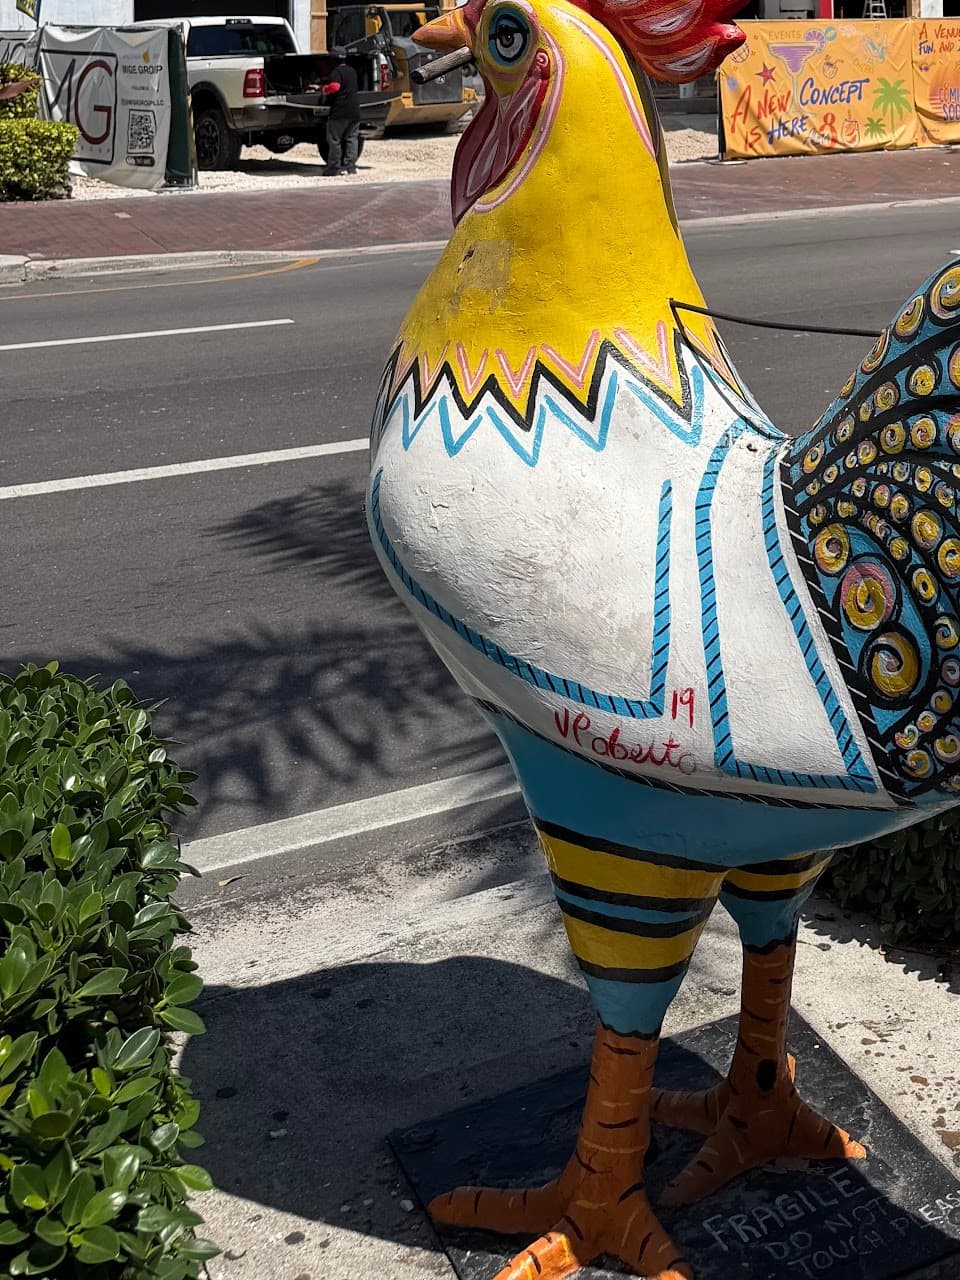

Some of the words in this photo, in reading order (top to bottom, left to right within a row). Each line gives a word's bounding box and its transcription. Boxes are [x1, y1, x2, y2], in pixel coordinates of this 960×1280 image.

[919, 22, 928, 40] A
[939, 42, 955, 54] AND
[731, 85, 751, 133] A
[756, 90, 791, 120] NEW
[800, 77, 870, 106] CONCEPT
[744, 126, 762, 152] IS
[767, 115, 809, 145] HERE
[671, 687, 695, 729] 19
[702, 1167, 866, 1252] FRAGILE
[765, 1231, 813, 1260] DO
[824, 1196, 889, 1234] NOT
[786, 1229, 885, 1280] TOUCH
